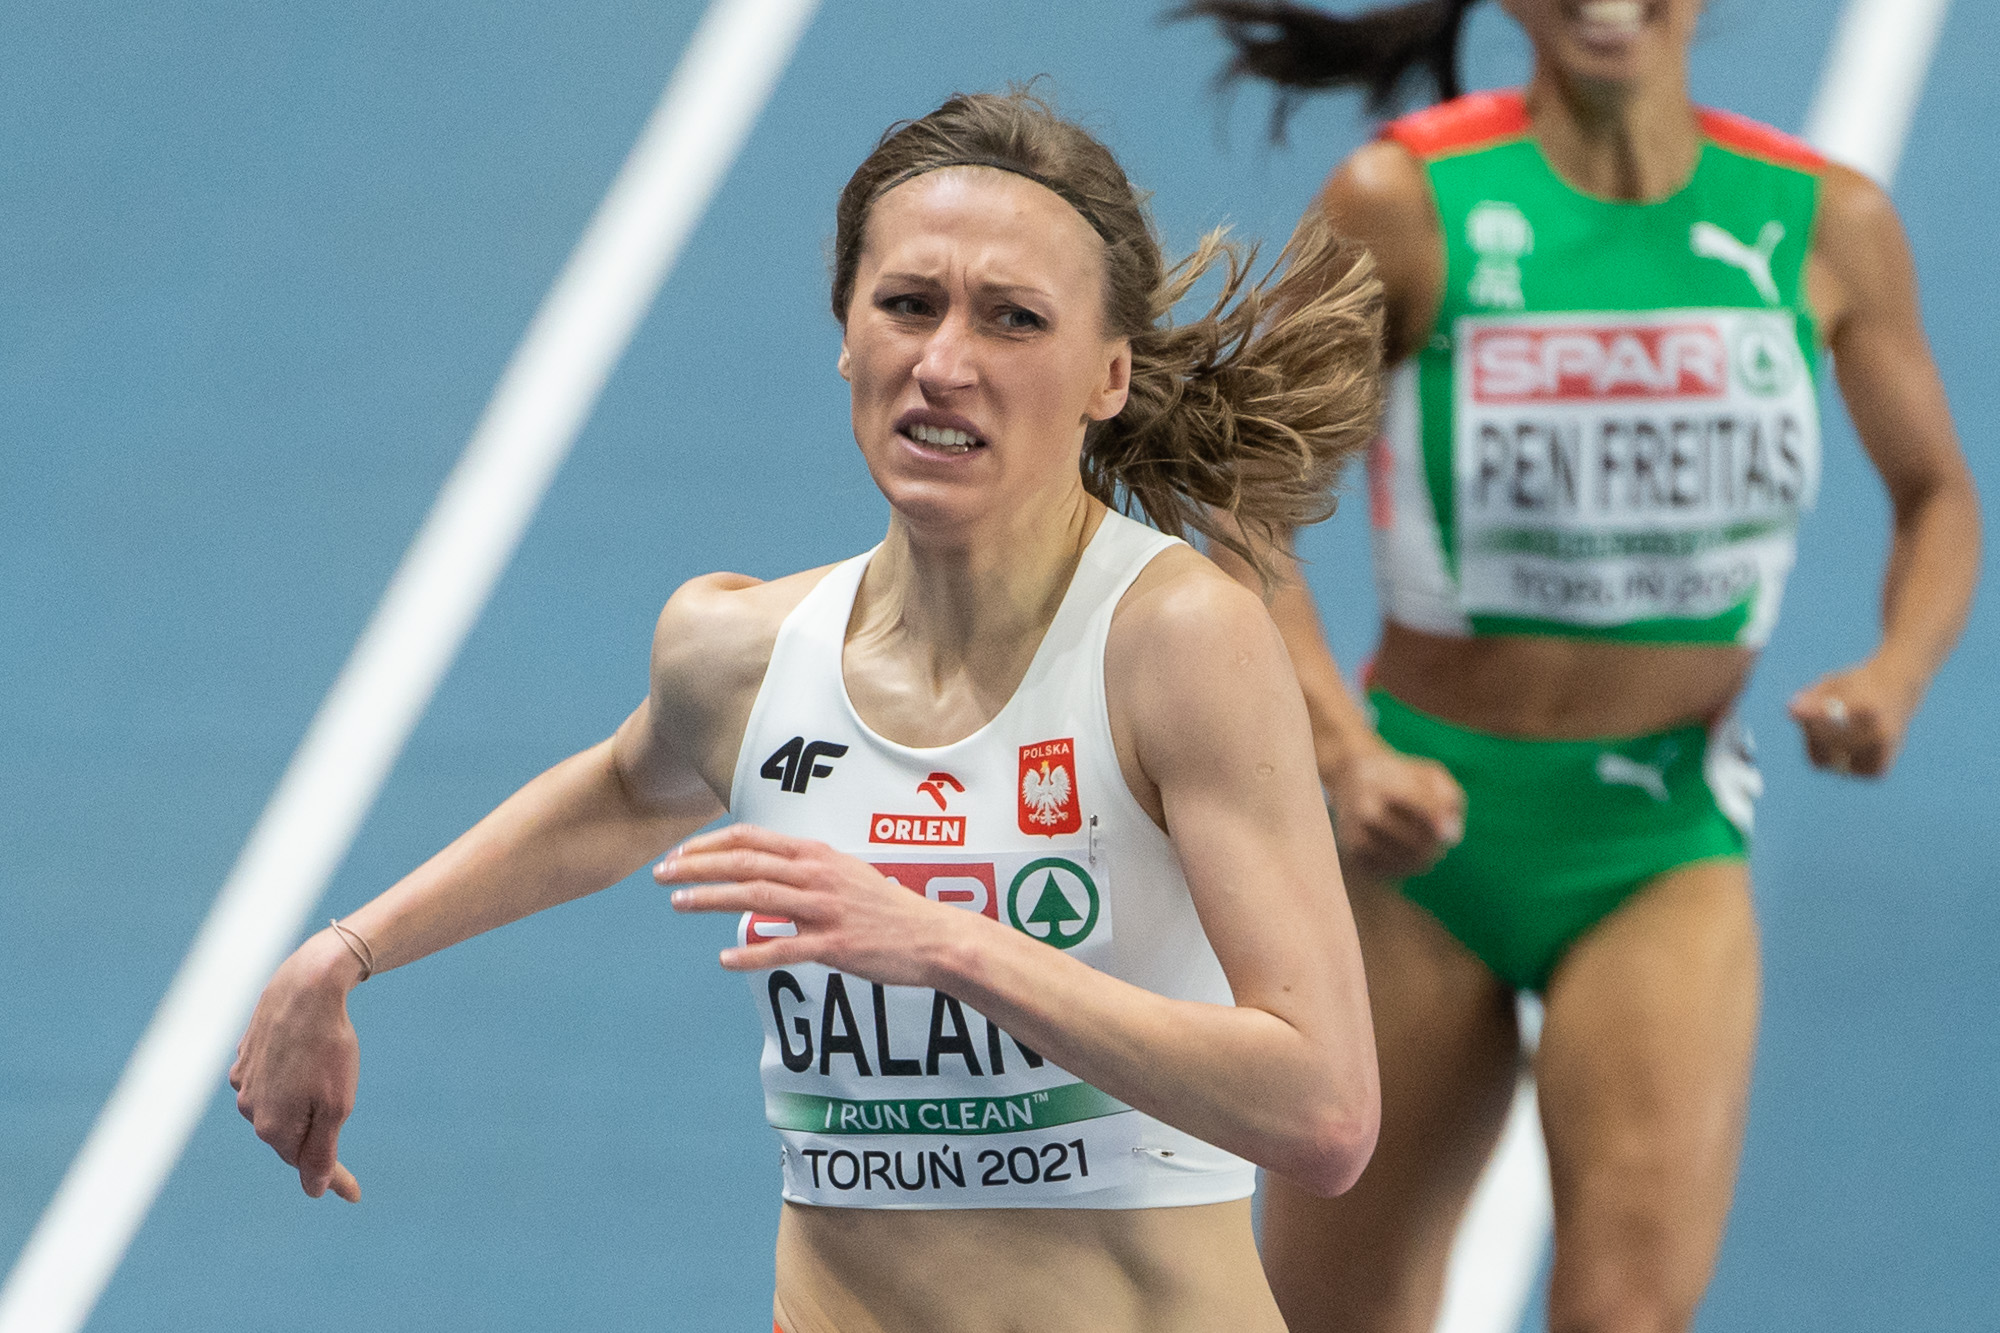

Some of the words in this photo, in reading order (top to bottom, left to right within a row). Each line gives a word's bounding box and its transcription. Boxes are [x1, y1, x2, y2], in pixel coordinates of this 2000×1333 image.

[1479, 332, 1720, 396] SPAR
[1600, 412, 1804, 507] FREITAS
[759, 735, 850, 794] 4F
[1022, 742, 1071, 760] POLSKA
[874, 818, 961, 842] ORLEN
[824, 1101, 834, 1129] I
[839, 1102, 911, 1131] RUN
[801, 1142, 968, 1191] TORUŃ
[976, 1137, 1090, 1187] 2021
